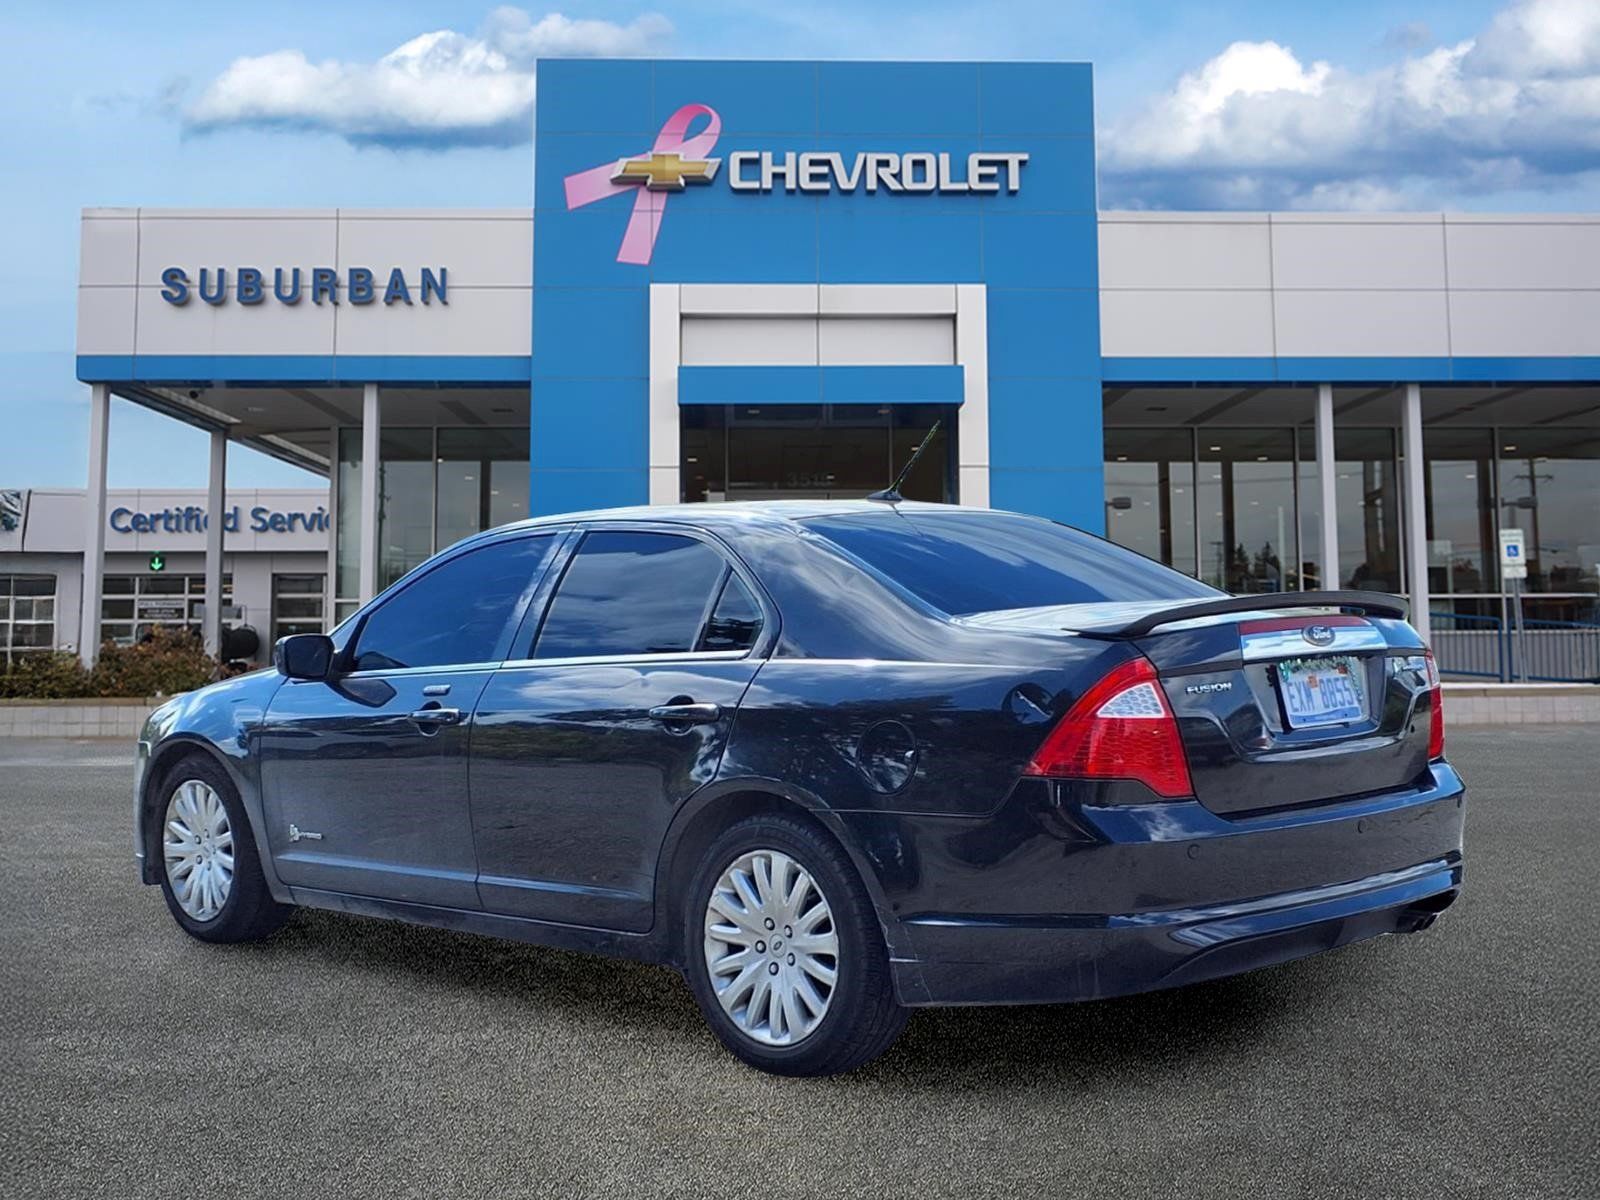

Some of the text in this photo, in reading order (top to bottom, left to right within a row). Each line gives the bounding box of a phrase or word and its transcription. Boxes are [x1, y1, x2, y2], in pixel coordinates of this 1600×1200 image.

[729, 151, 1029, 193] CHEVROLET
[161, 267, 449, 306] SUBURBAN
[1186, 682, 1232, 695] FUSION
